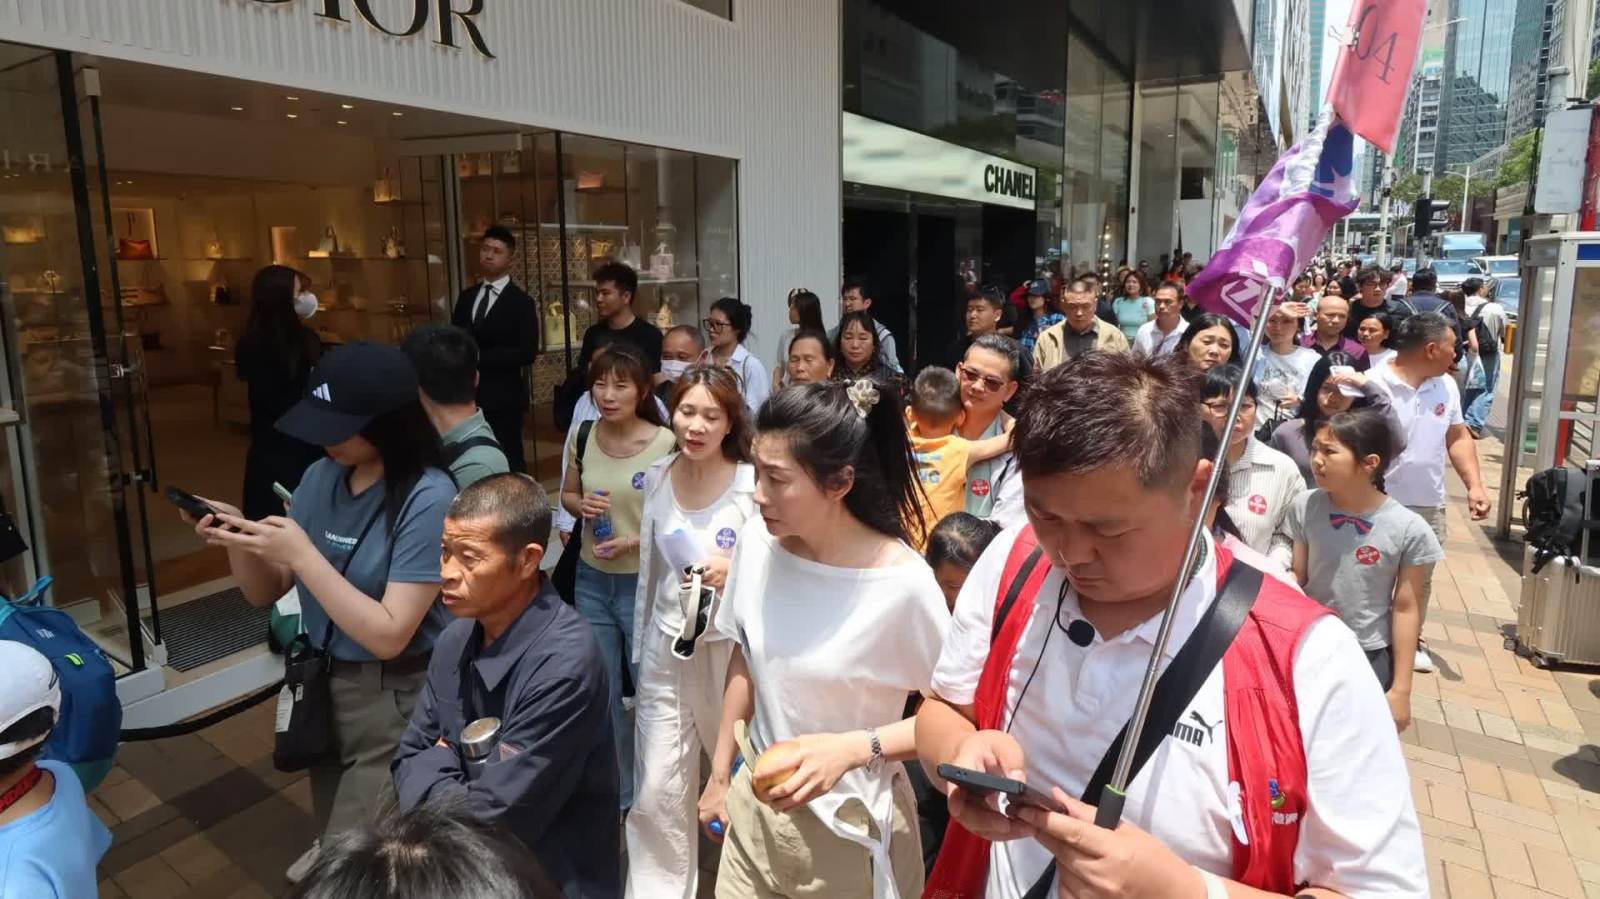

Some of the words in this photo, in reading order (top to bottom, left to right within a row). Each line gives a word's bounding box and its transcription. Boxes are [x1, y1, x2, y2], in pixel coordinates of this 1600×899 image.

[1355, 4, 1398, 85] 04
[984, 163, 1035, 200] CHANEL
[1173, 722, 1204, 747] MA
